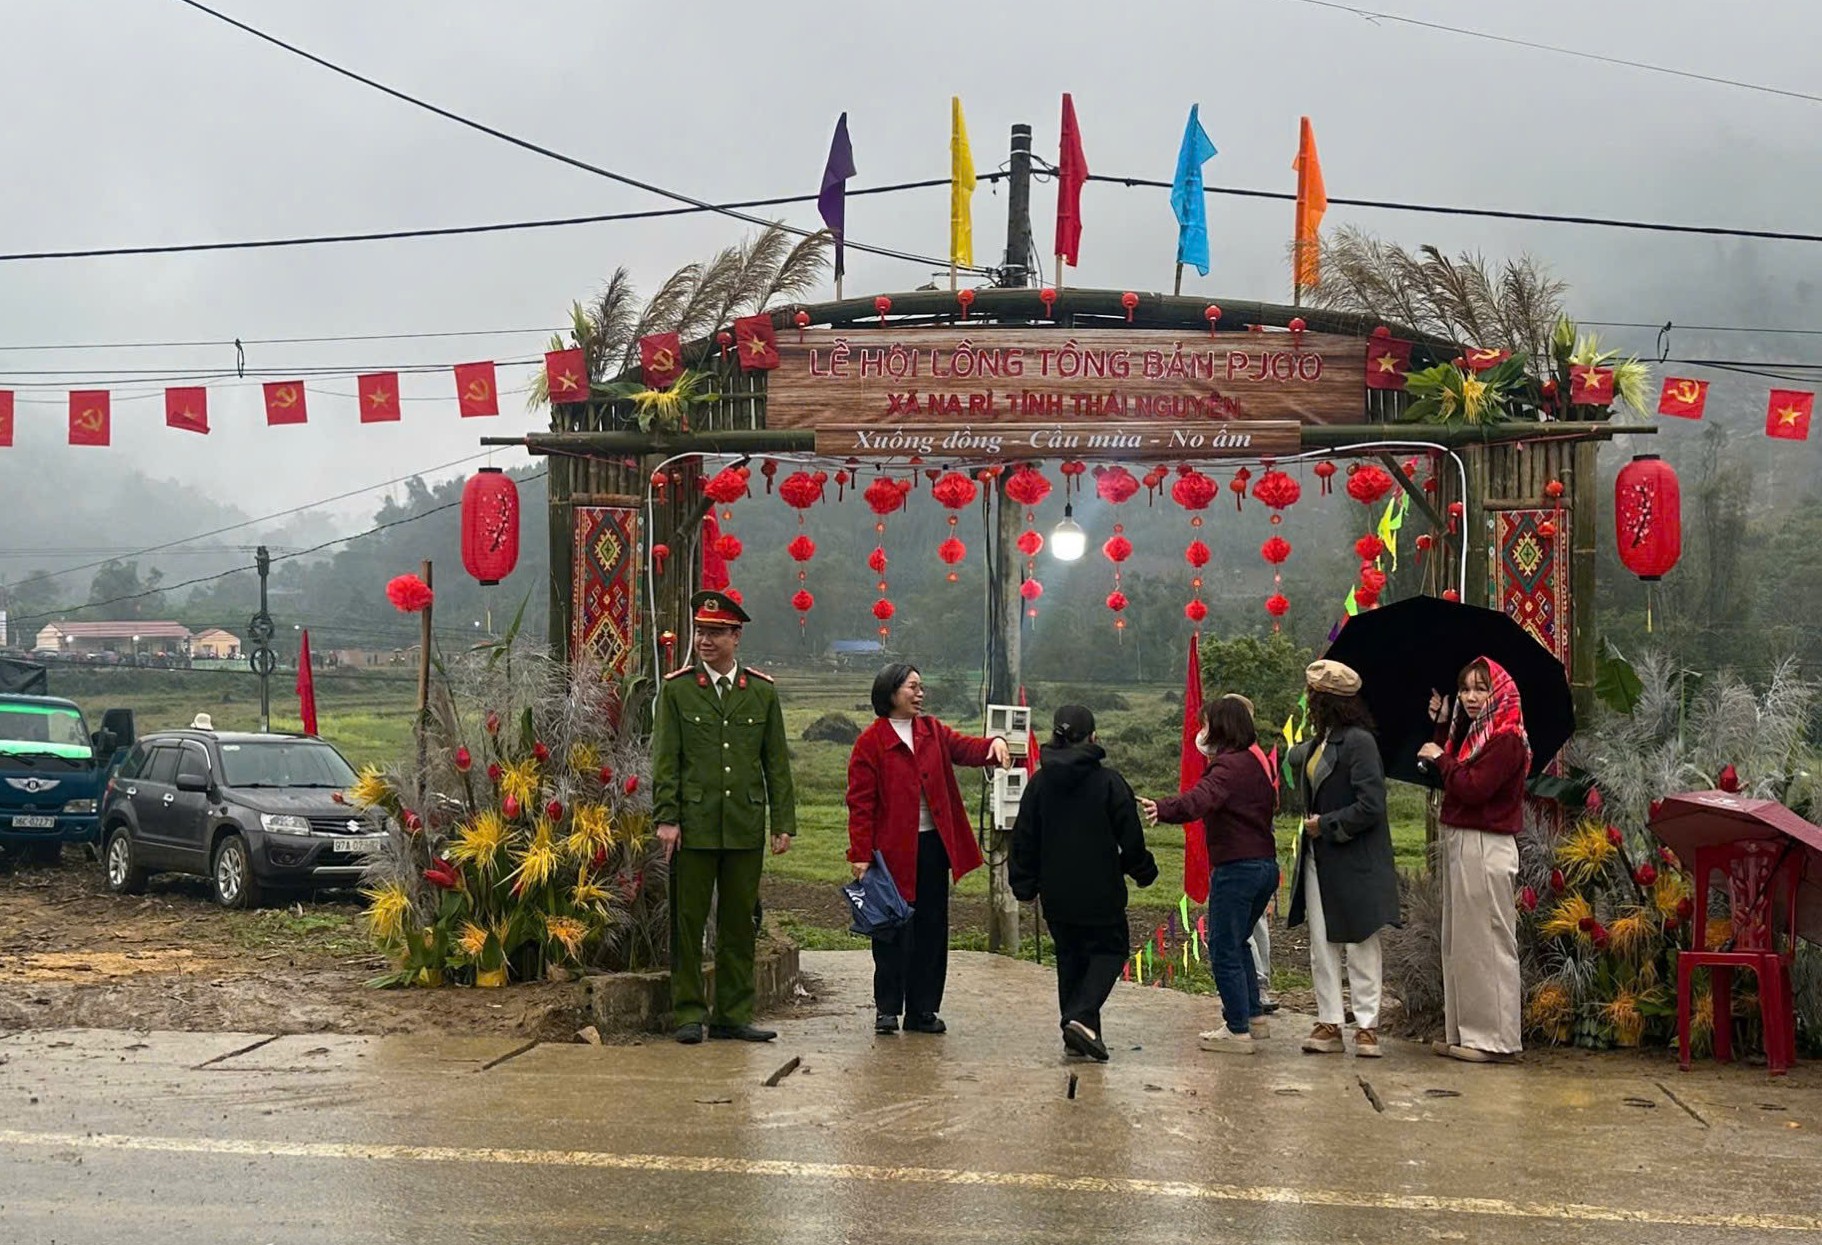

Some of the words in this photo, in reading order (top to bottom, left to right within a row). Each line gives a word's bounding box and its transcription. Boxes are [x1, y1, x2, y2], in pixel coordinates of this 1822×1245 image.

[809, 338, 850, 378] LỄ
[860, 342, 918, 383] HỘI
[931, 338, 1024, 378] LỒNG
[1035, 338, 1132, 379] TỒNG
[1142, 341, 1215, 381] BẢN
[887, 389, 922, 416] XÃ
[928, 394, 963, 416] NA
[1006, 389, 1063, 417] TỈNH
[1070, 389, 1127, 417] THÁI
[1134, 391, 1242, 419] NGUYÊN
[853, 427, 935, 454] Xuống
[1029, 424, 1079, 449] Cầu
[1087, 429, 1143, 449] mùa
[1168, 429, 1204, 448] No
[1212, 424, 1251, 448] ấm
